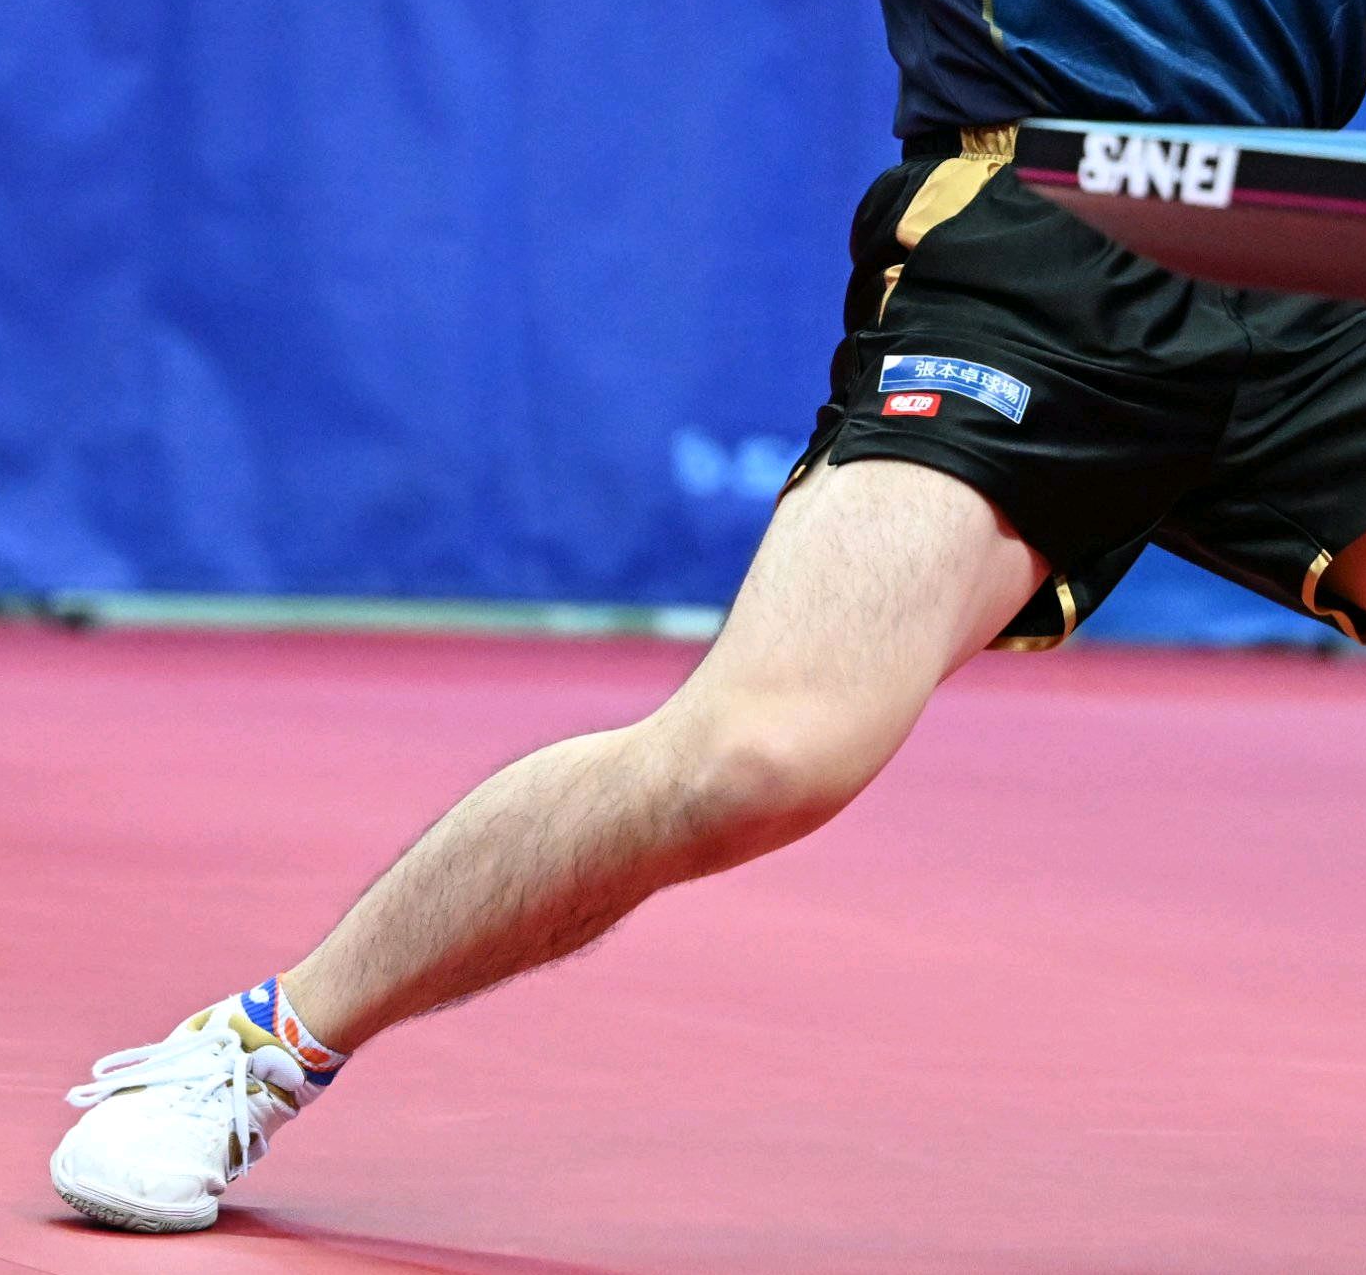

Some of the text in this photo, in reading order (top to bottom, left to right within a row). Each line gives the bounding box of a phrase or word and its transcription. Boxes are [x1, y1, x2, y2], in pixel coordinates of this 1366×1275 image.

[1077, 130, 1241, 210] SANEI
[914, 360, 1021, 403] 張本卓球場
